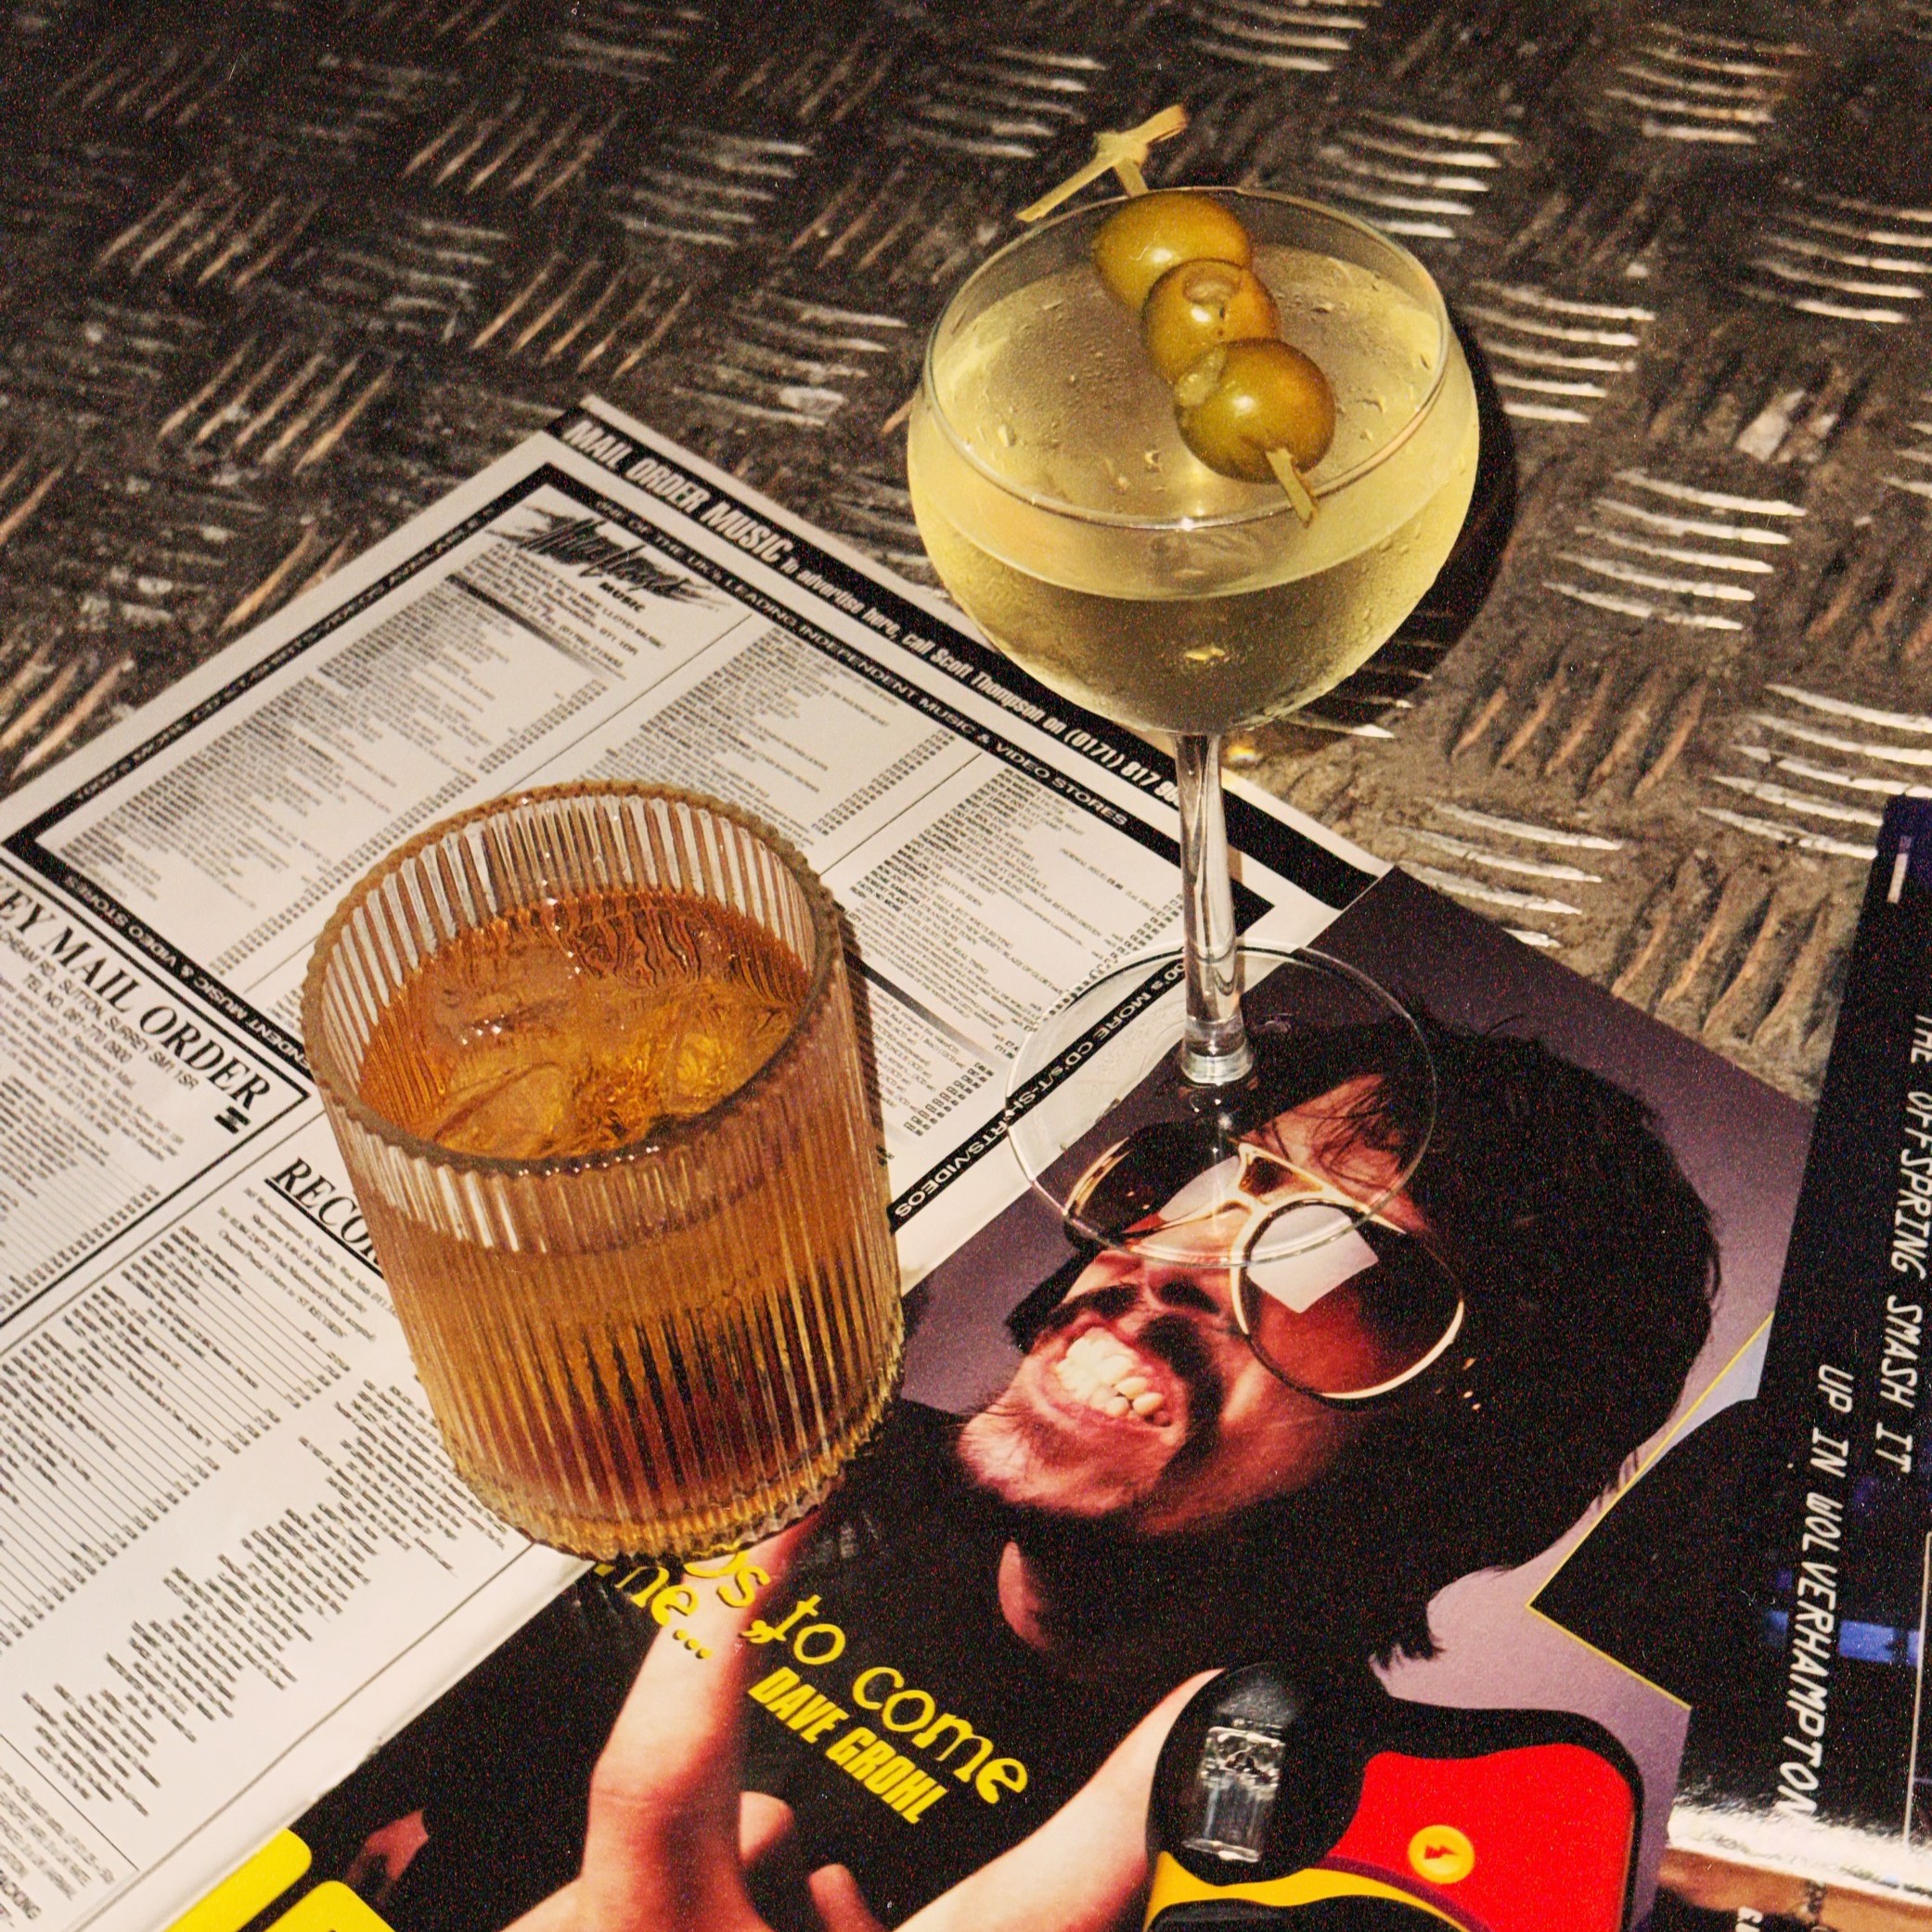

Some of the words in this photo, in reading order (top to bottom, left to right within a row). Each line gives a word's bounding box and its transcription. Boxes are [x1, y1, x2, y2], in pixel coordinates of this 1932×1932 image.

[560, 417, 633, 468] MAIL
[624, 455, 712, 515] ORDER
[699, 499, 795, 565] MUSIC
[779, 556, 801, 573] To
[794, 568, 867, 612] advertise
[859, 607, 903, 638] here,
[901, 632, 936, 656] call
[929, 648, 975, 678] Scott
[968, 672, 1049, 722] Thompson
[1042, 716, 1067, 734] on
[1062, 728, 1126, 769] (0171)
[1119, 760, 1162, 789] 817
[596, 581, 647, 613] MUSIC
[627, 520, 650, 535] OF
[652, 535, 683, 555] THE
[723, 579, 800, 625] LEADING
[797, 625, 920, 700] INDEPENDENT
[918, 697, 977, 735] MUSIC
[976, 732, 992, 744] &
[994, 741, 1051, 779] VIDEO
[1051, 776, 1128, 826] STORES
[61, 871, 130, 929] STORES
[125, 921, 179, 966] VIDEO
[177, 963, 196, 977] &
[0, 884, 58, 934] EY
[41, 927, 141, 1013] MAIL
[139, 1006, 271, 1110] ORDER
[21, 974, 45, 992] TEL
[192, 972, 249, 1021] MUSIC
[103, 1015, 151, 1053] SURREY
[1092, 987, 1151, 1042] MORE
[892, 1035, 1096, 1223] CD's/T-SHRTS/VIDEOS
[1891, 1091, 1932, 1280] OFFSPRING
[1883, 1294, 1923, 1409] SMASH
[1817, 1364, 1854, 1413] UP
[1810, 1427, 1848, 1478] IN
[1875, 1422, 1913, 1473] IT
[1776, 1490, 1843, 1813] WOLVERHAMPTON
[767, 1593, 846, 1665] to
[853, 1667, 1028, 1804] come
[747, 1667, 850, 1744] DAVE
[825, 1727, 948, 1824] GROHL
